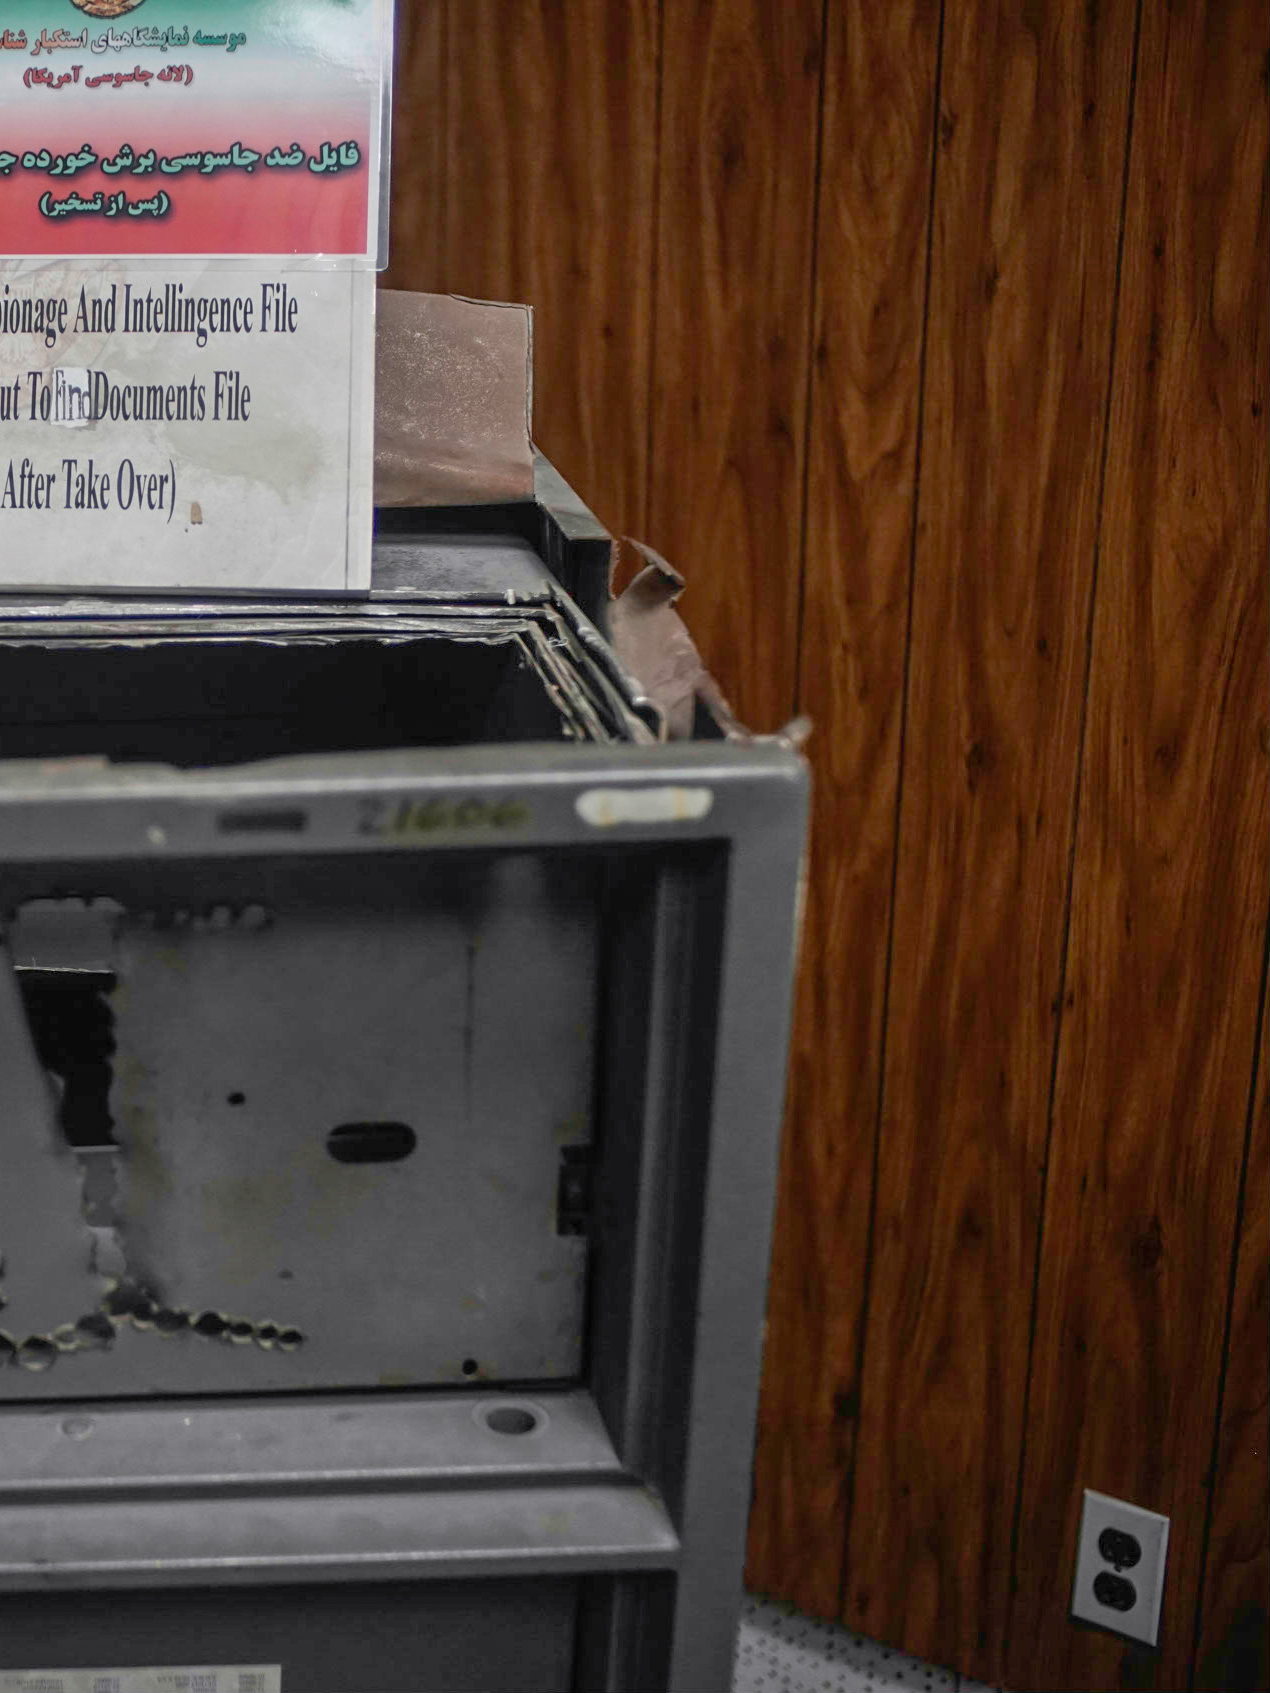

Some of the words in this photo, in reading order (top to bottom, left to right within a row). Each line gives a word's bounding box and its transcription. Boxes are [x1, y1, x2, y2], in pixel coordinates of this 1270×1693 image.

[30, 28, 88, 55] استکبار
[192, 29, 246, 52] موسسه
[85, 65, 153, 87] جاسوسی
[22, 143, 98, 175] خورده
[101, 144, 156, 174] برش
[160, 143, 260, 173] جاسوسی
[264, 143, 304, 167] ضد
[308, 142, 360, 172] فایل
[104, 191, 126, 216] از
[74, 283, 117, 335] And
[122, 283, 253, 347] Intellingence
[260, 283, 298, 335] File
[27, 370, 51, 421] To
[93, 370, 206, 421] Documents
[212, 370, 251, 421] File
[62, 458, 110, 510] Take
[117, 458, 176, 524] Over)
